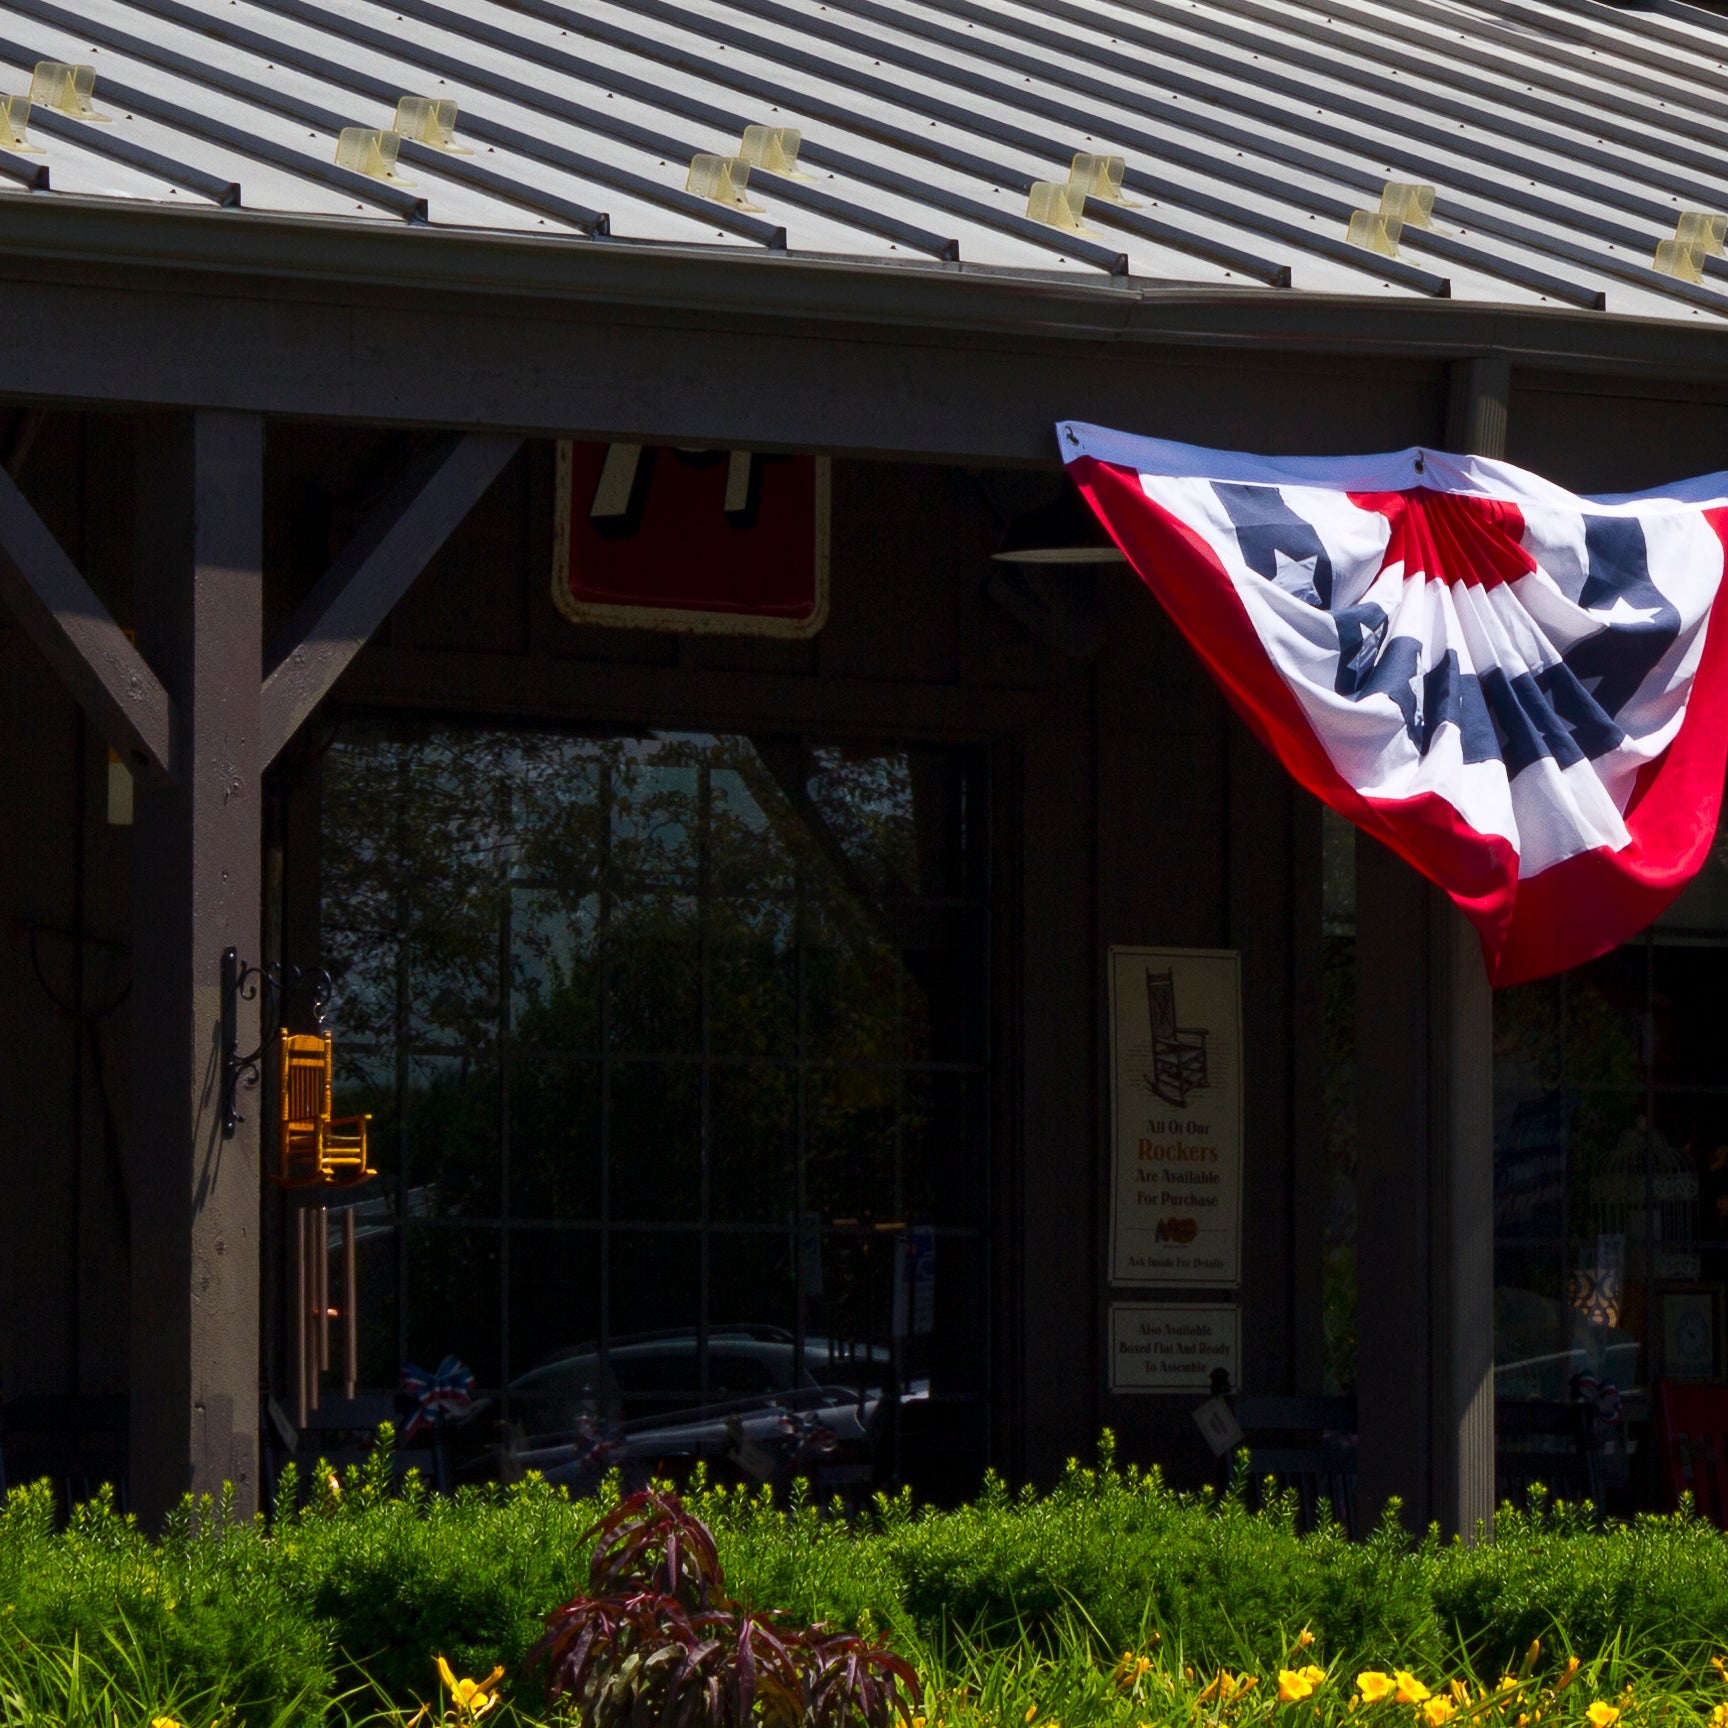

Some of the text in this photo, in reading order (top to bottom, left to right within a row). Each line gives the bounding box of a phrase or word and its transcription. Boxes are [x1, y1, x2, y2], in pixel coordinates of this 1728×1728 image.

[1146, 1119, 1165, 1133] All
[1186, 1121, 1210, 1135] Our
[1137, 1138, 1218, 1162] Rockers
[1135, 1168, 1220, 1184] Are Available
[1137, 1191, 1218, 1206] For Purchase
